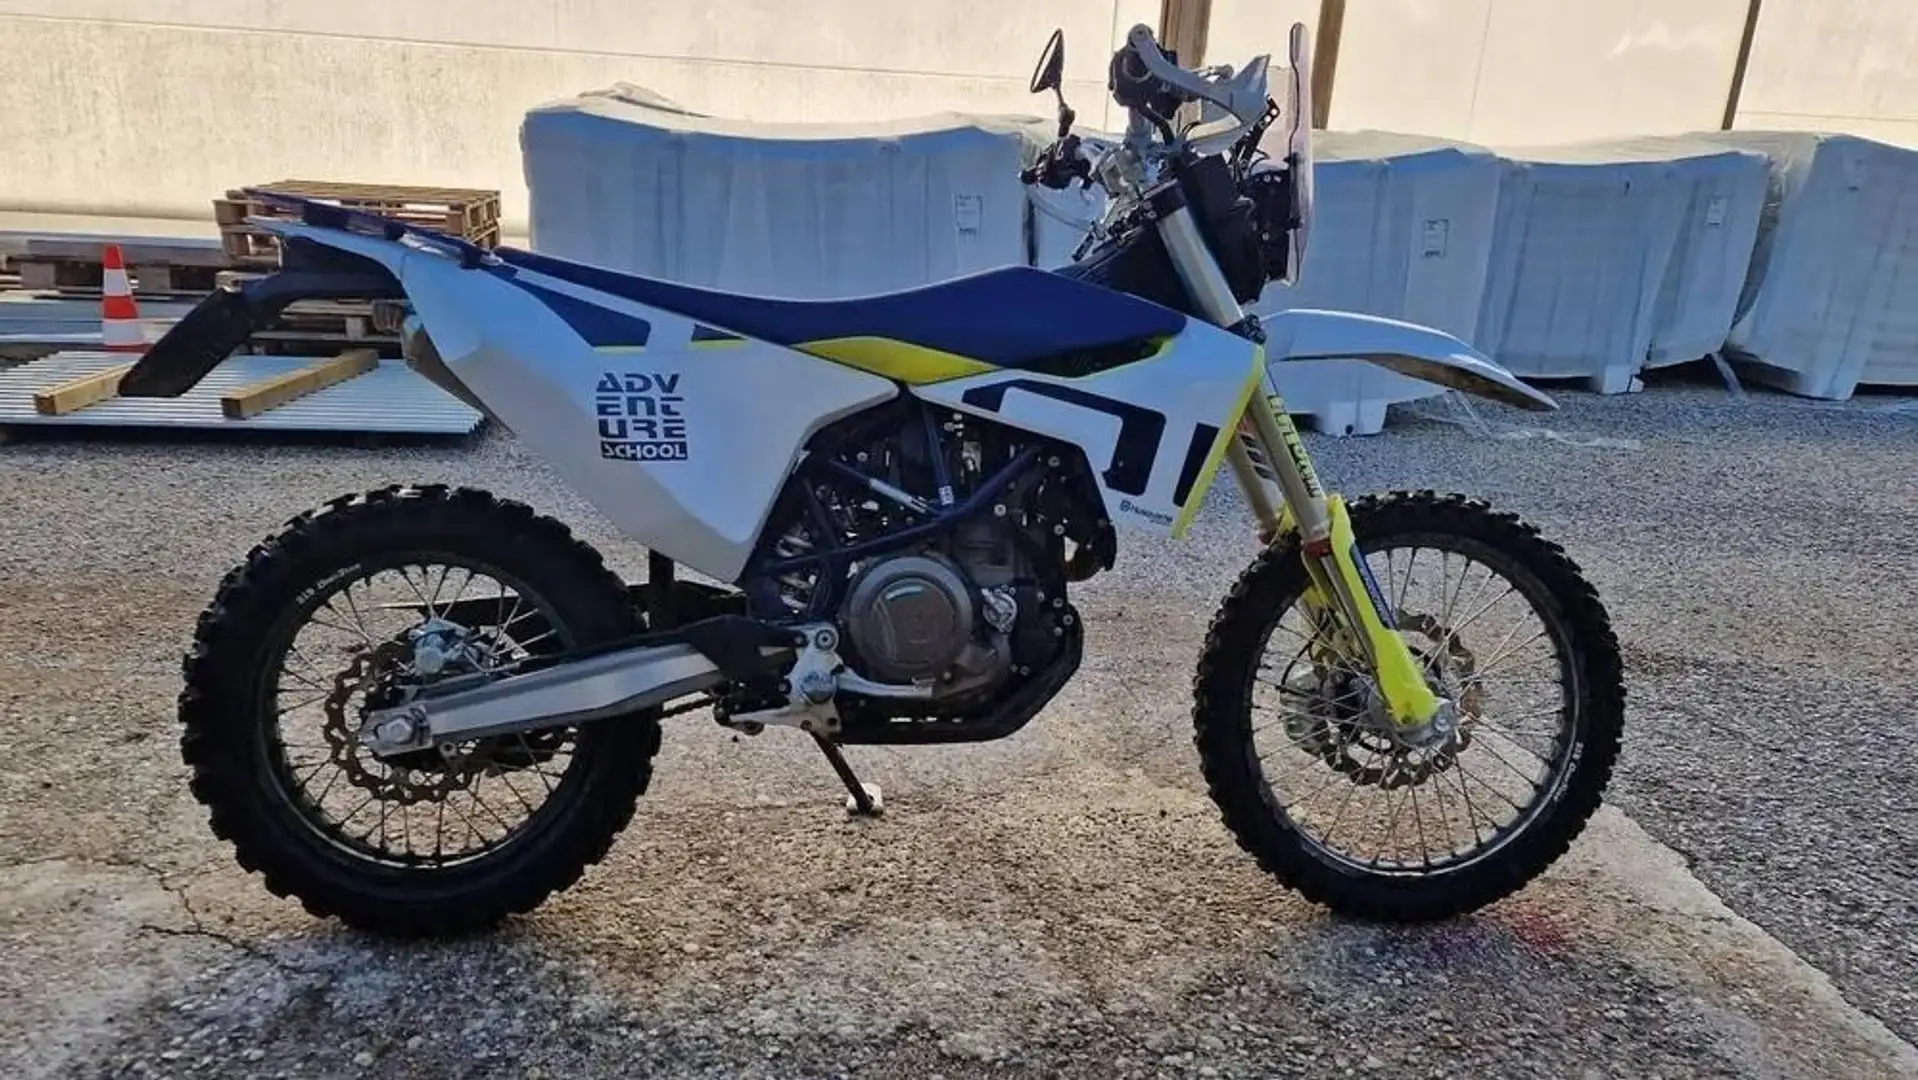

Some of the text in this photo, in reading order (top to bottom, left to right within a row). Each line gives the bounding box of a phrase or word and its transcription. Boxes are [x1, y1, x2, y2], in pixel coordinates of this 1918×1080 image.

[596, 372, 679, 393] ADV
[598, 418, 686, 439] URE
[603, 443, 686, 459] SCHOOL
